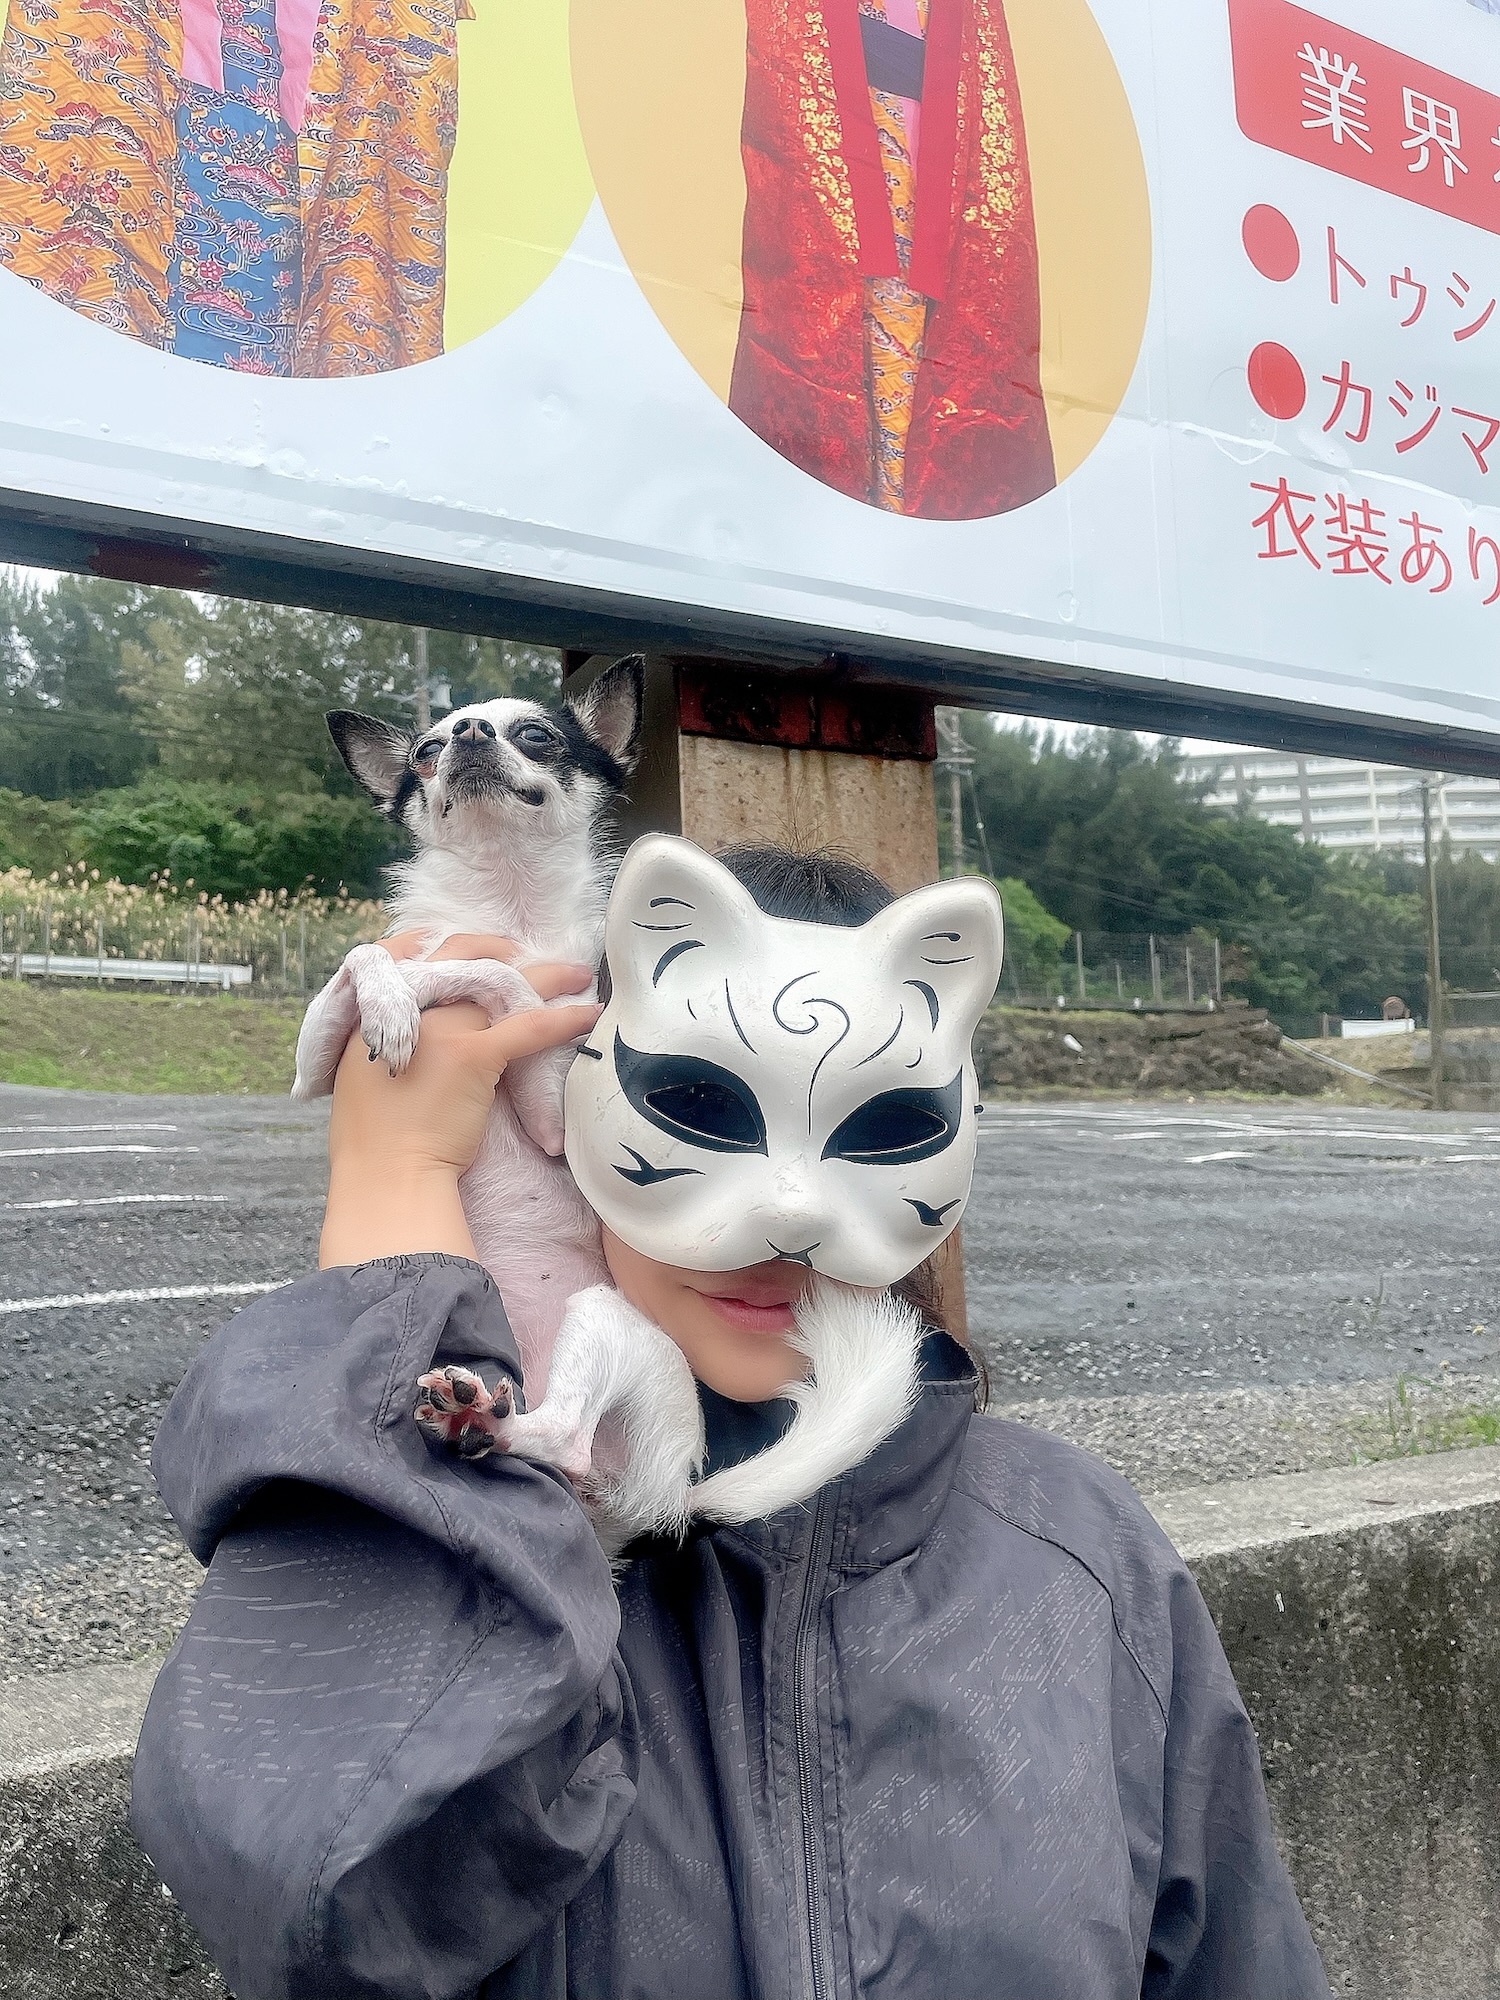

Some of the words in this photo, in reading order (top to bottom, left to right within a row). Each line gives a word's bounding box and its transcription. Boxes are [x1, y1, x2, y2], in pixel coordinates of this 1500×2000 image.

[1297, 42, 1500, 187] 業界
[1322, 360, 1500, 474] カジマ
[1250, 477, 1500, 605] 衣装あり
